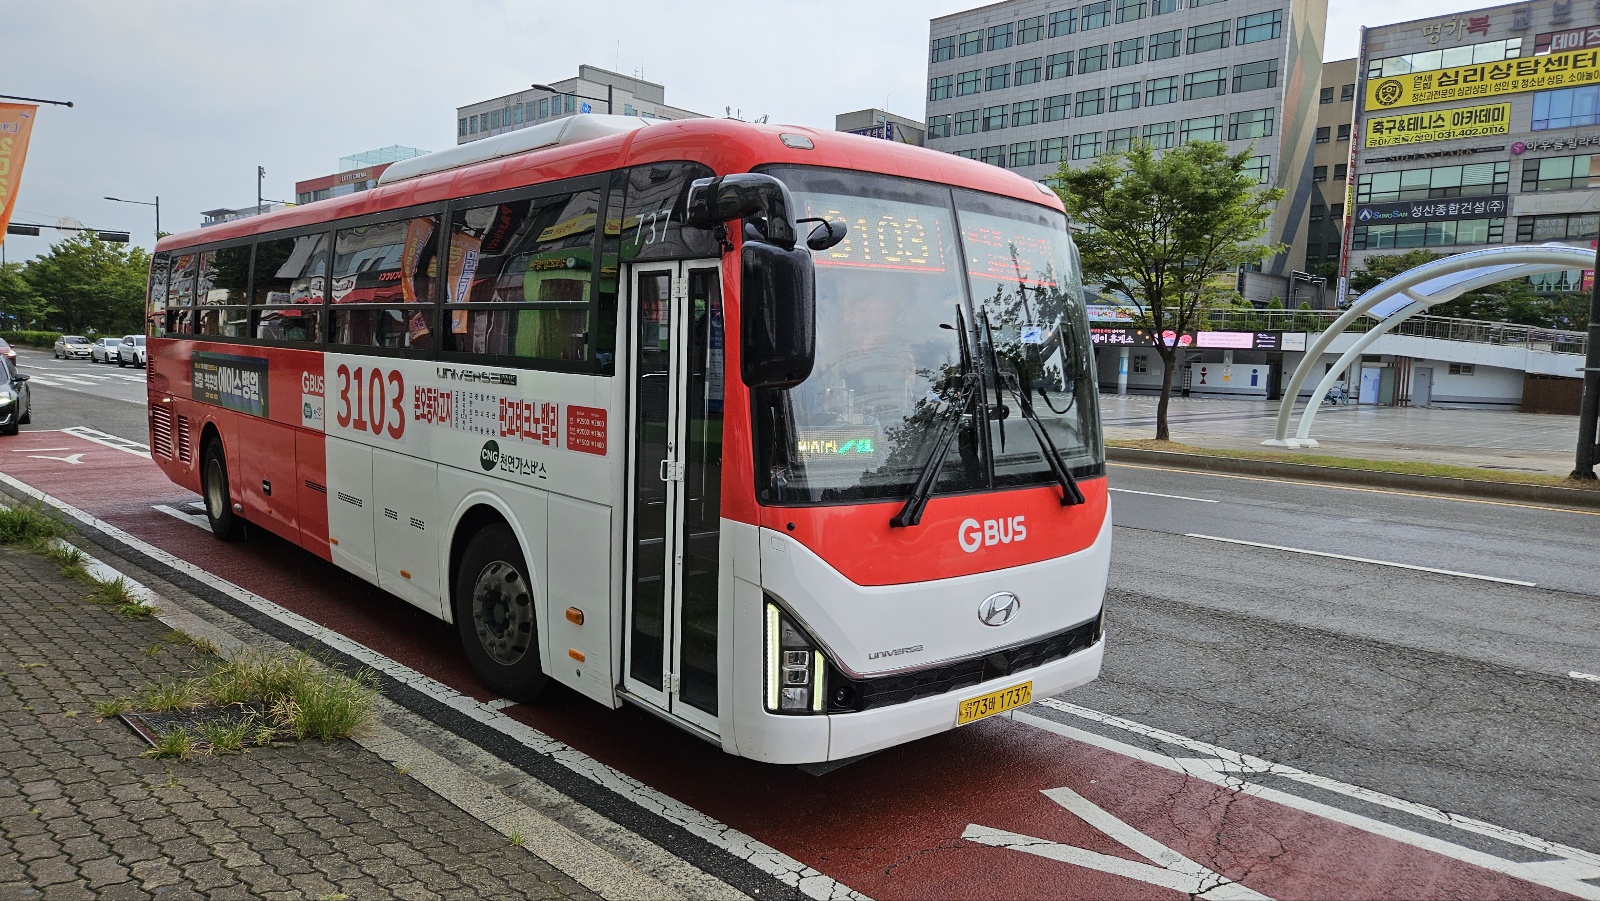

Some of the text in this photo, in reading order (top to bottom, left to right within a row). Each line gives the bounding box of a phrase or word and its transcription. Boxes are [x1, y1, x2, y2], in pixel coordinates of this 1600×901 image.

[1437, 51, 1598, 87] 심리상담센터
[1411, 88, 1455, 102] 정신과전문의
[1457, 84, 1488, 97] 심리상담
[1494, 81, 1509, 92] 성인
[1511, 80, 1519, 90] 및
[1521, 76, 1545, 88] 청소년
[1372, 106, 1505, 135] 축구&테니스 아카데미
[1437, 126, 1505, 139] 031.402.0116
[1411, 200, 1504, 218] 성산종합건설(주)
[635, 208, 673, 246] 737
[301, 370, 324, 394] GBUS
[436, 367, 500, 384] UNIVERSE
[336, 363, 406, 440] 3103
[414, 385, 453, 428] 본오동차고지
[498, 396, 559, 448] 판교테크노밸리
[481, 448, 498, 463] CNG
[500, 453, 547, 480] 천연가스버스
[958, 515, 1027, 553] GBUS
[868, 644, 924, 660] UNIVERSE
[973, 696, 996, 718] 73바
[999, 685, 1028, 709] 1737
